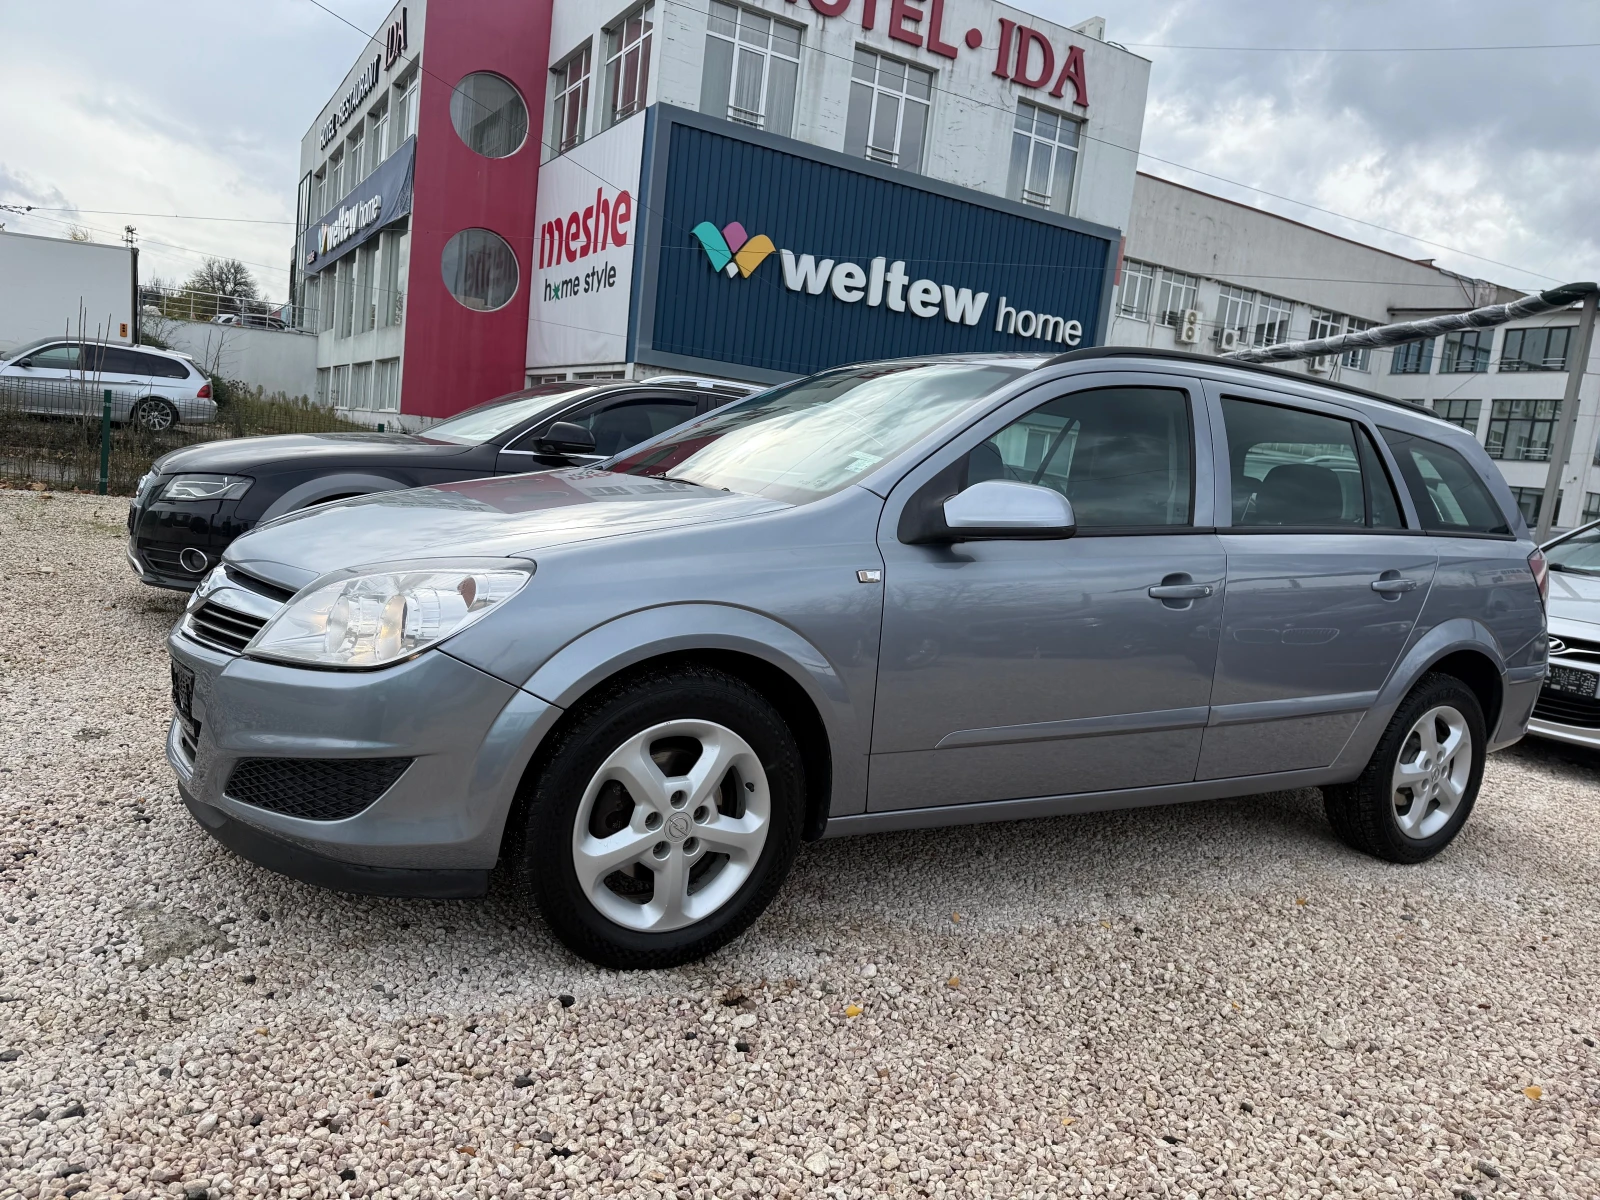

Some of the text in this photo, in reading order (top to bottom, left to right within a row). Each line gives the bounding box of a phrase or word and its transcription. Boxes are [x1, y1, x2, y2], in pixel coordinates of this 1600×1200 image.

[992, 17, 1089, 107] IDA
[538, 186, 632, 270] meshe
[583, 260, 617, 294] style
[780, 248, 1083, 346] weltew home
